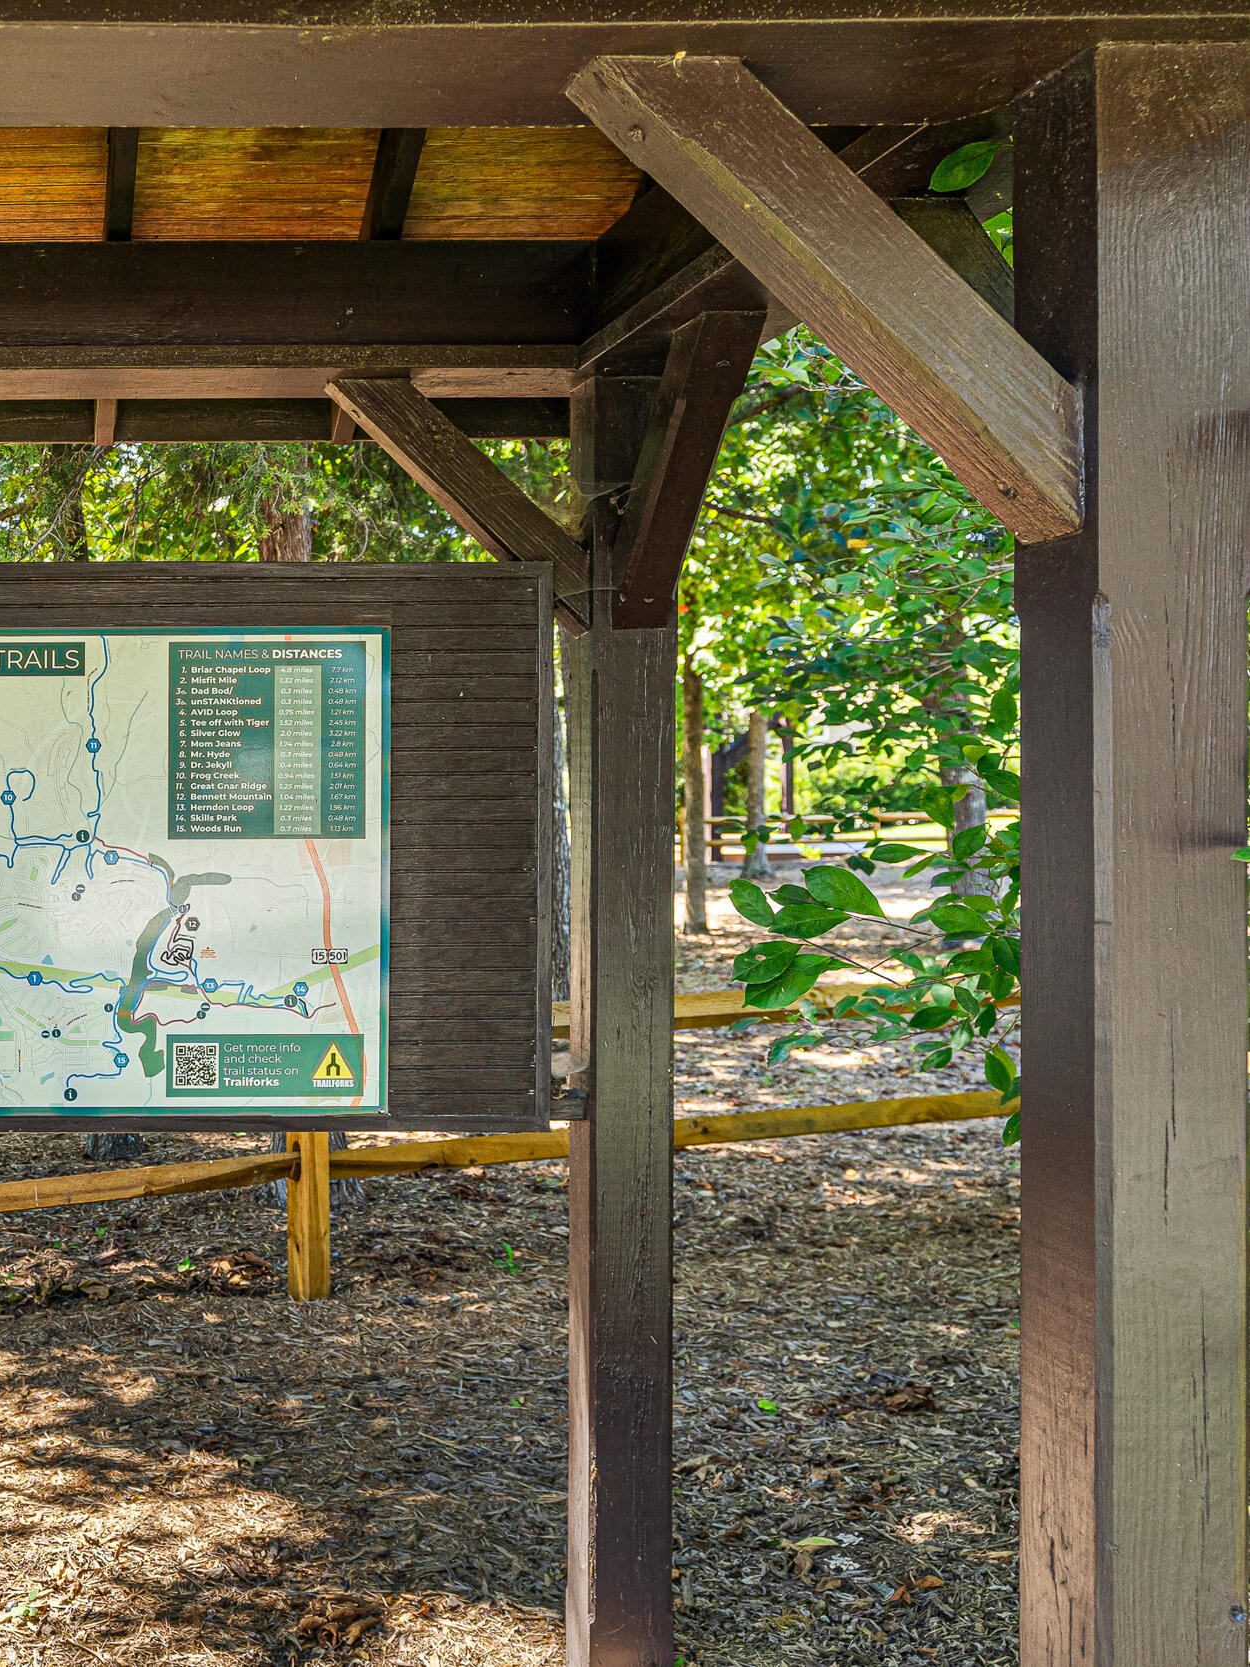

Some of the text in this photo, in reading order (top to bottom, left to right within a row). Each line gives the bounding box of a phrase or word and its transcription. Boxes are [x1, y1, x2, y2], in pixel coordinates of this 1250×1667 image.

[178, 649, 342, 659] TRAIL NAMES & DISTANCES
[181, 666, 271, 675] 1. Briar Chapel Loop
[191, 687, 209, 695] Dad
[212, 687, 233, 695] Bod/
[215, 709, 238, 717] Loop
[179, 719, 270, 728] 5. Tee off with Tiger
[207, 751, 231, 760] Hyde
[205, 762, 233, 770] Jekyll
[191, 772, 211, 781] Frog
[241, 783, 267, 791] Ridge
[232, 804, 254, 813] Loop
[315, 951, 346, 961] 15 501
[224, 1044, 300, 1052] Get more info
[224, 1055, 281, 1063] and check
[223, 1067, 244, 1075] trail
[248, 1067, 281, 1075] status
[224, 1078, 279, 1086] Trailforks
